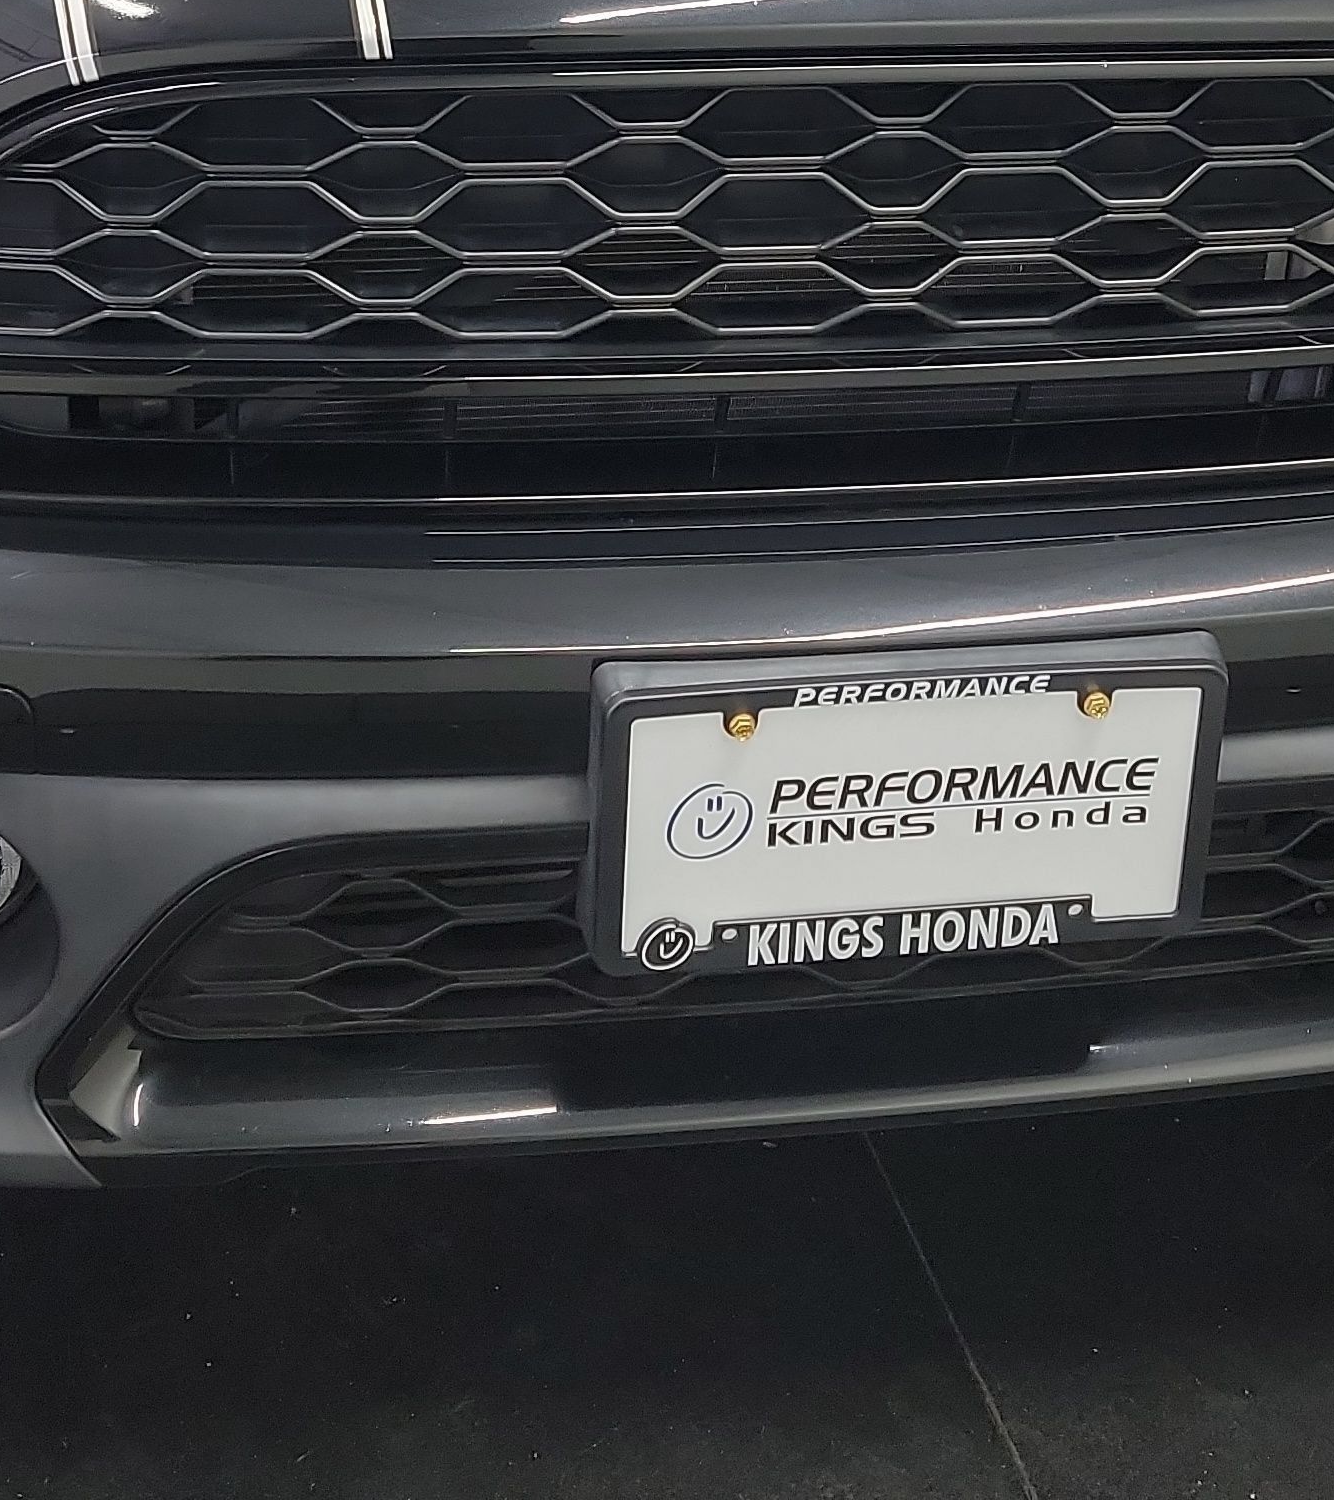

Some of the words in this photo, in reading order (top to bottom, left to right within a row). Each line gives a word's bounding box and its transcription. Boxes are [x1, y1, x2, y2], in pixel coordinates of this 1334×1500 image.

[793, 674, 1051, 708] PERFORMANCE
[769, 756, 1160, 815] PERFORMANCE
[767, 812, 935, 847] KINGS
[974, 801, 1147, 833] Honda
[747, 916, 884, 967] KINGS
[899, 903, 1059, 956] HONDA
